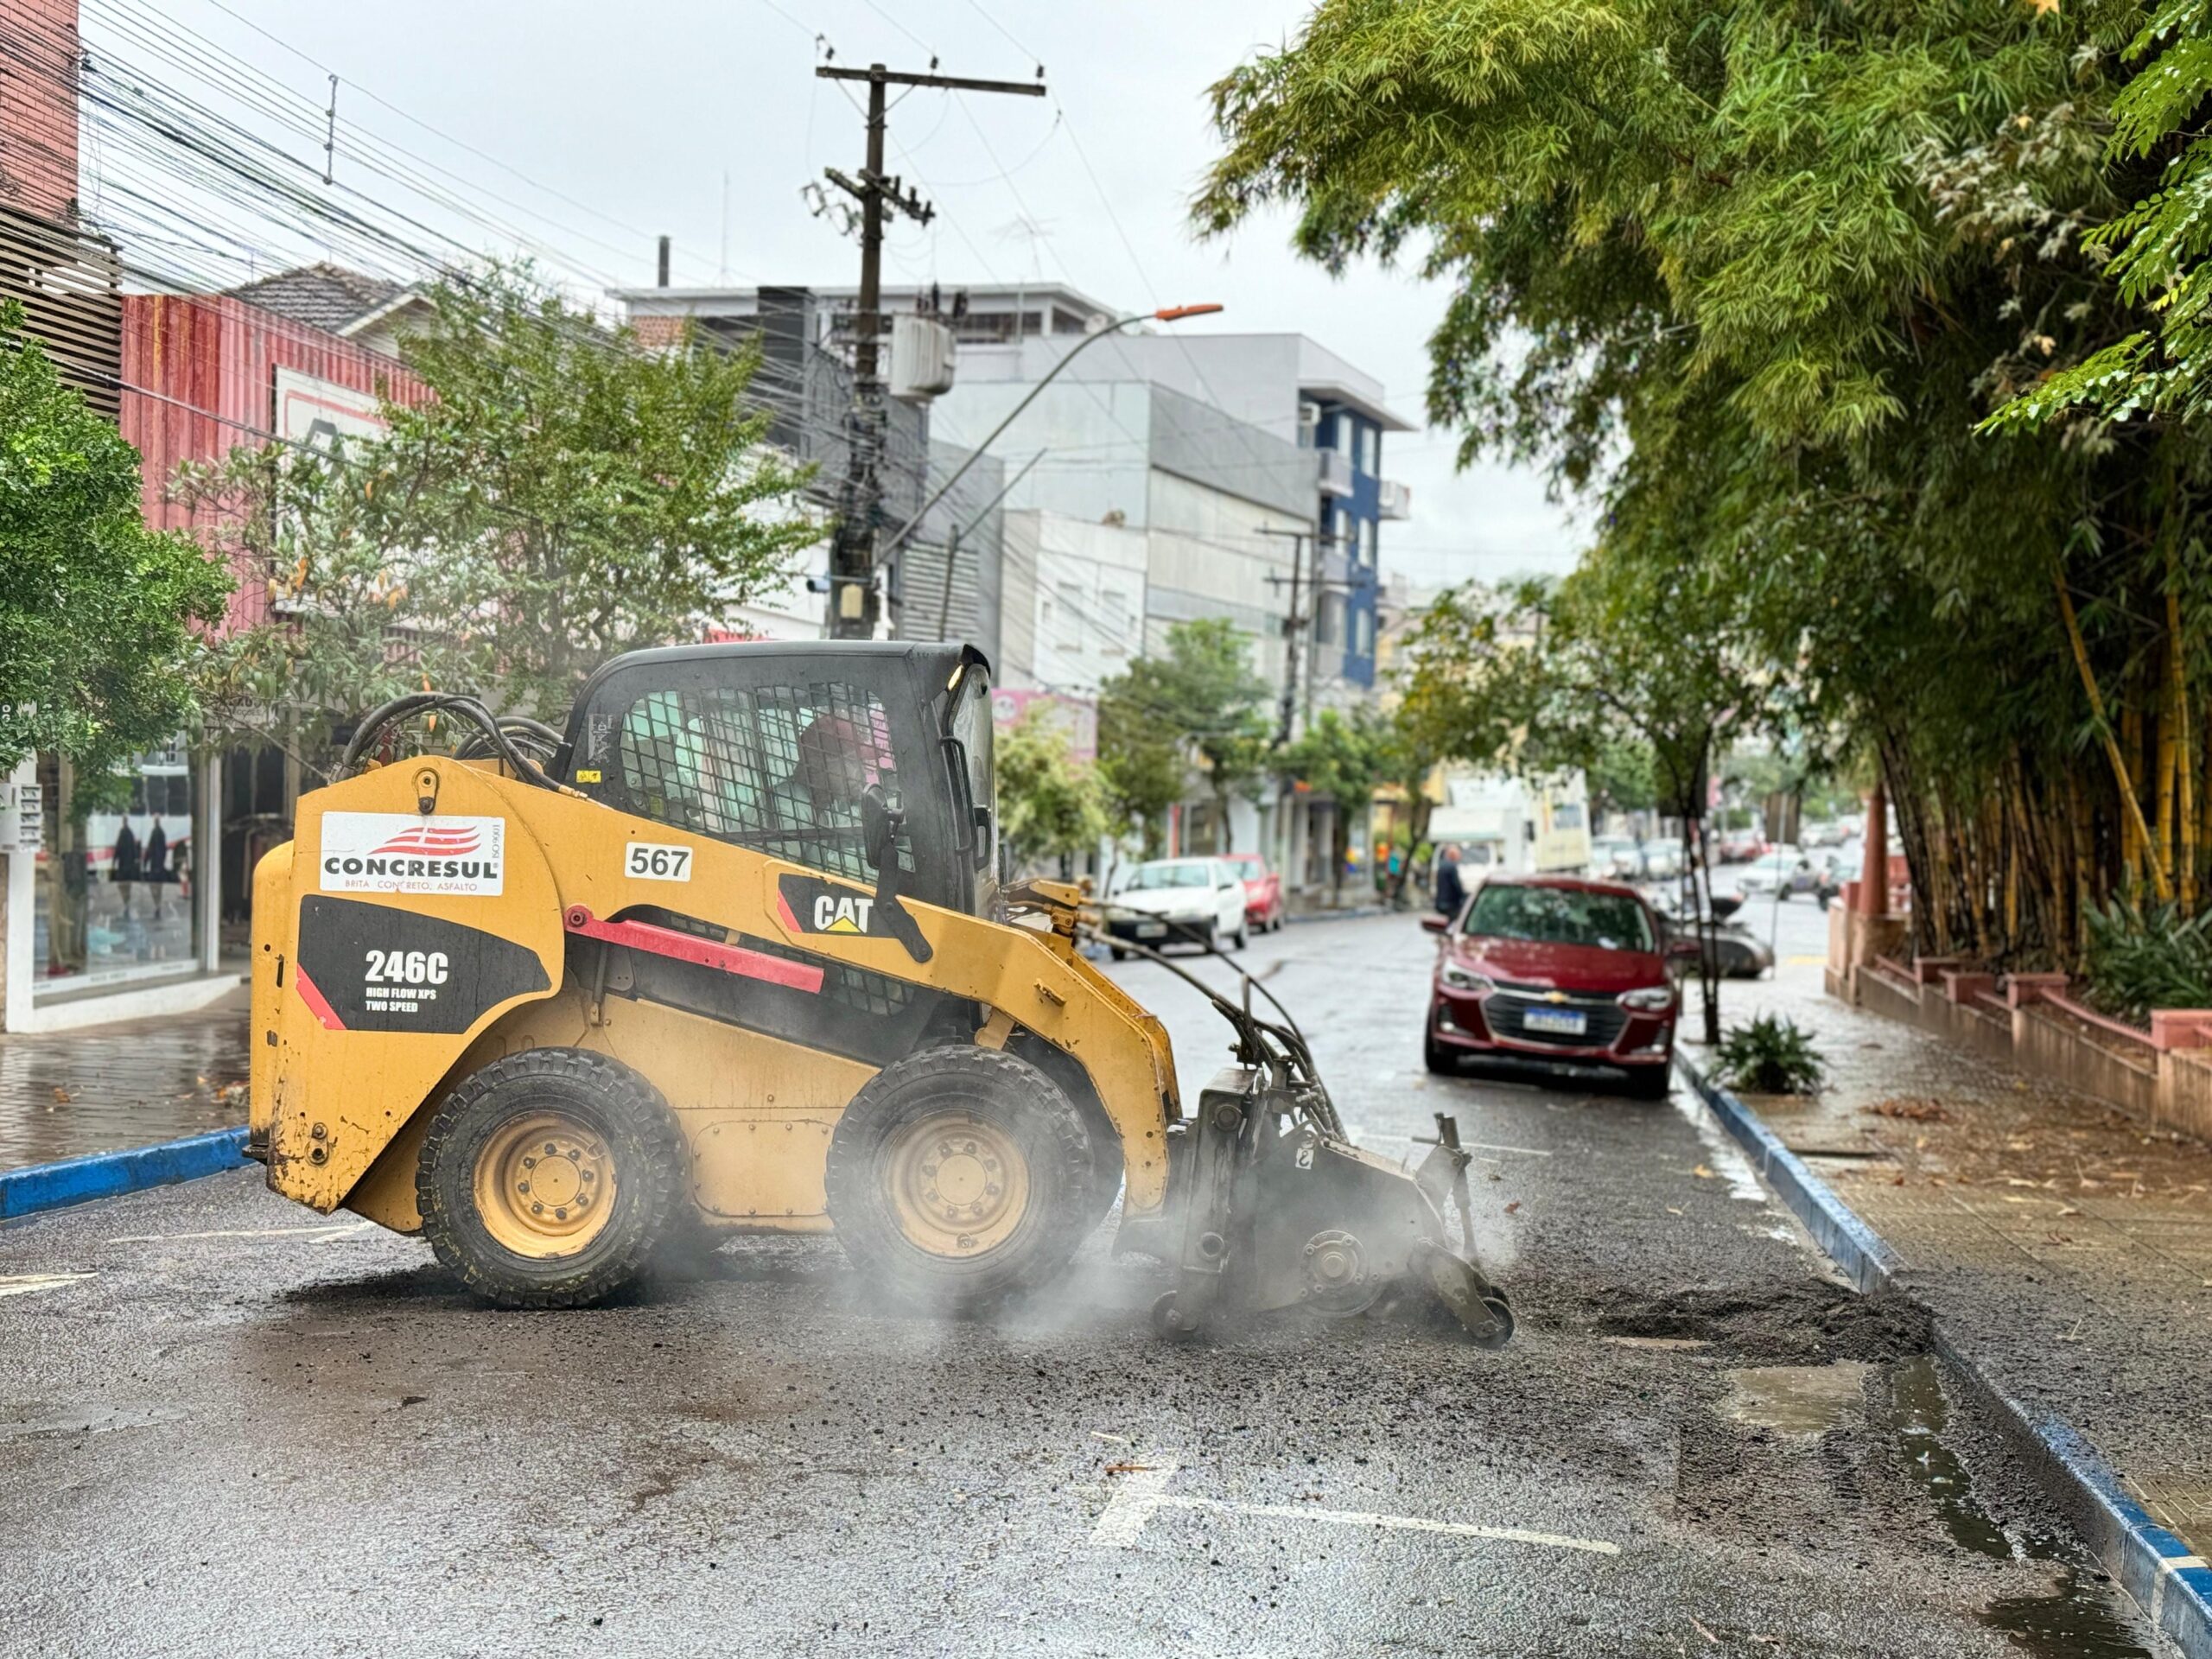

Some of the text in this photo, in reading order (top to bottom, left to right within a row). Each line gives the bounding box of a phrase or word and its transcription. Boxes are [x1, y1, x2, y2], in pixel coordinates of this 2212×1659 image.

[325, 857, 497, 879] CONCRESUL
[631, 848, 689, 876] 567
[437, 883, 477, 892] ASFALTO
[814, 895, 874, 933] CAT
[365, 950, 448, 984] 246C
[365, 987, 436, 1000] HIGH FLOW XPS
[365, 1001, 418, 1013] TWO SPEED
